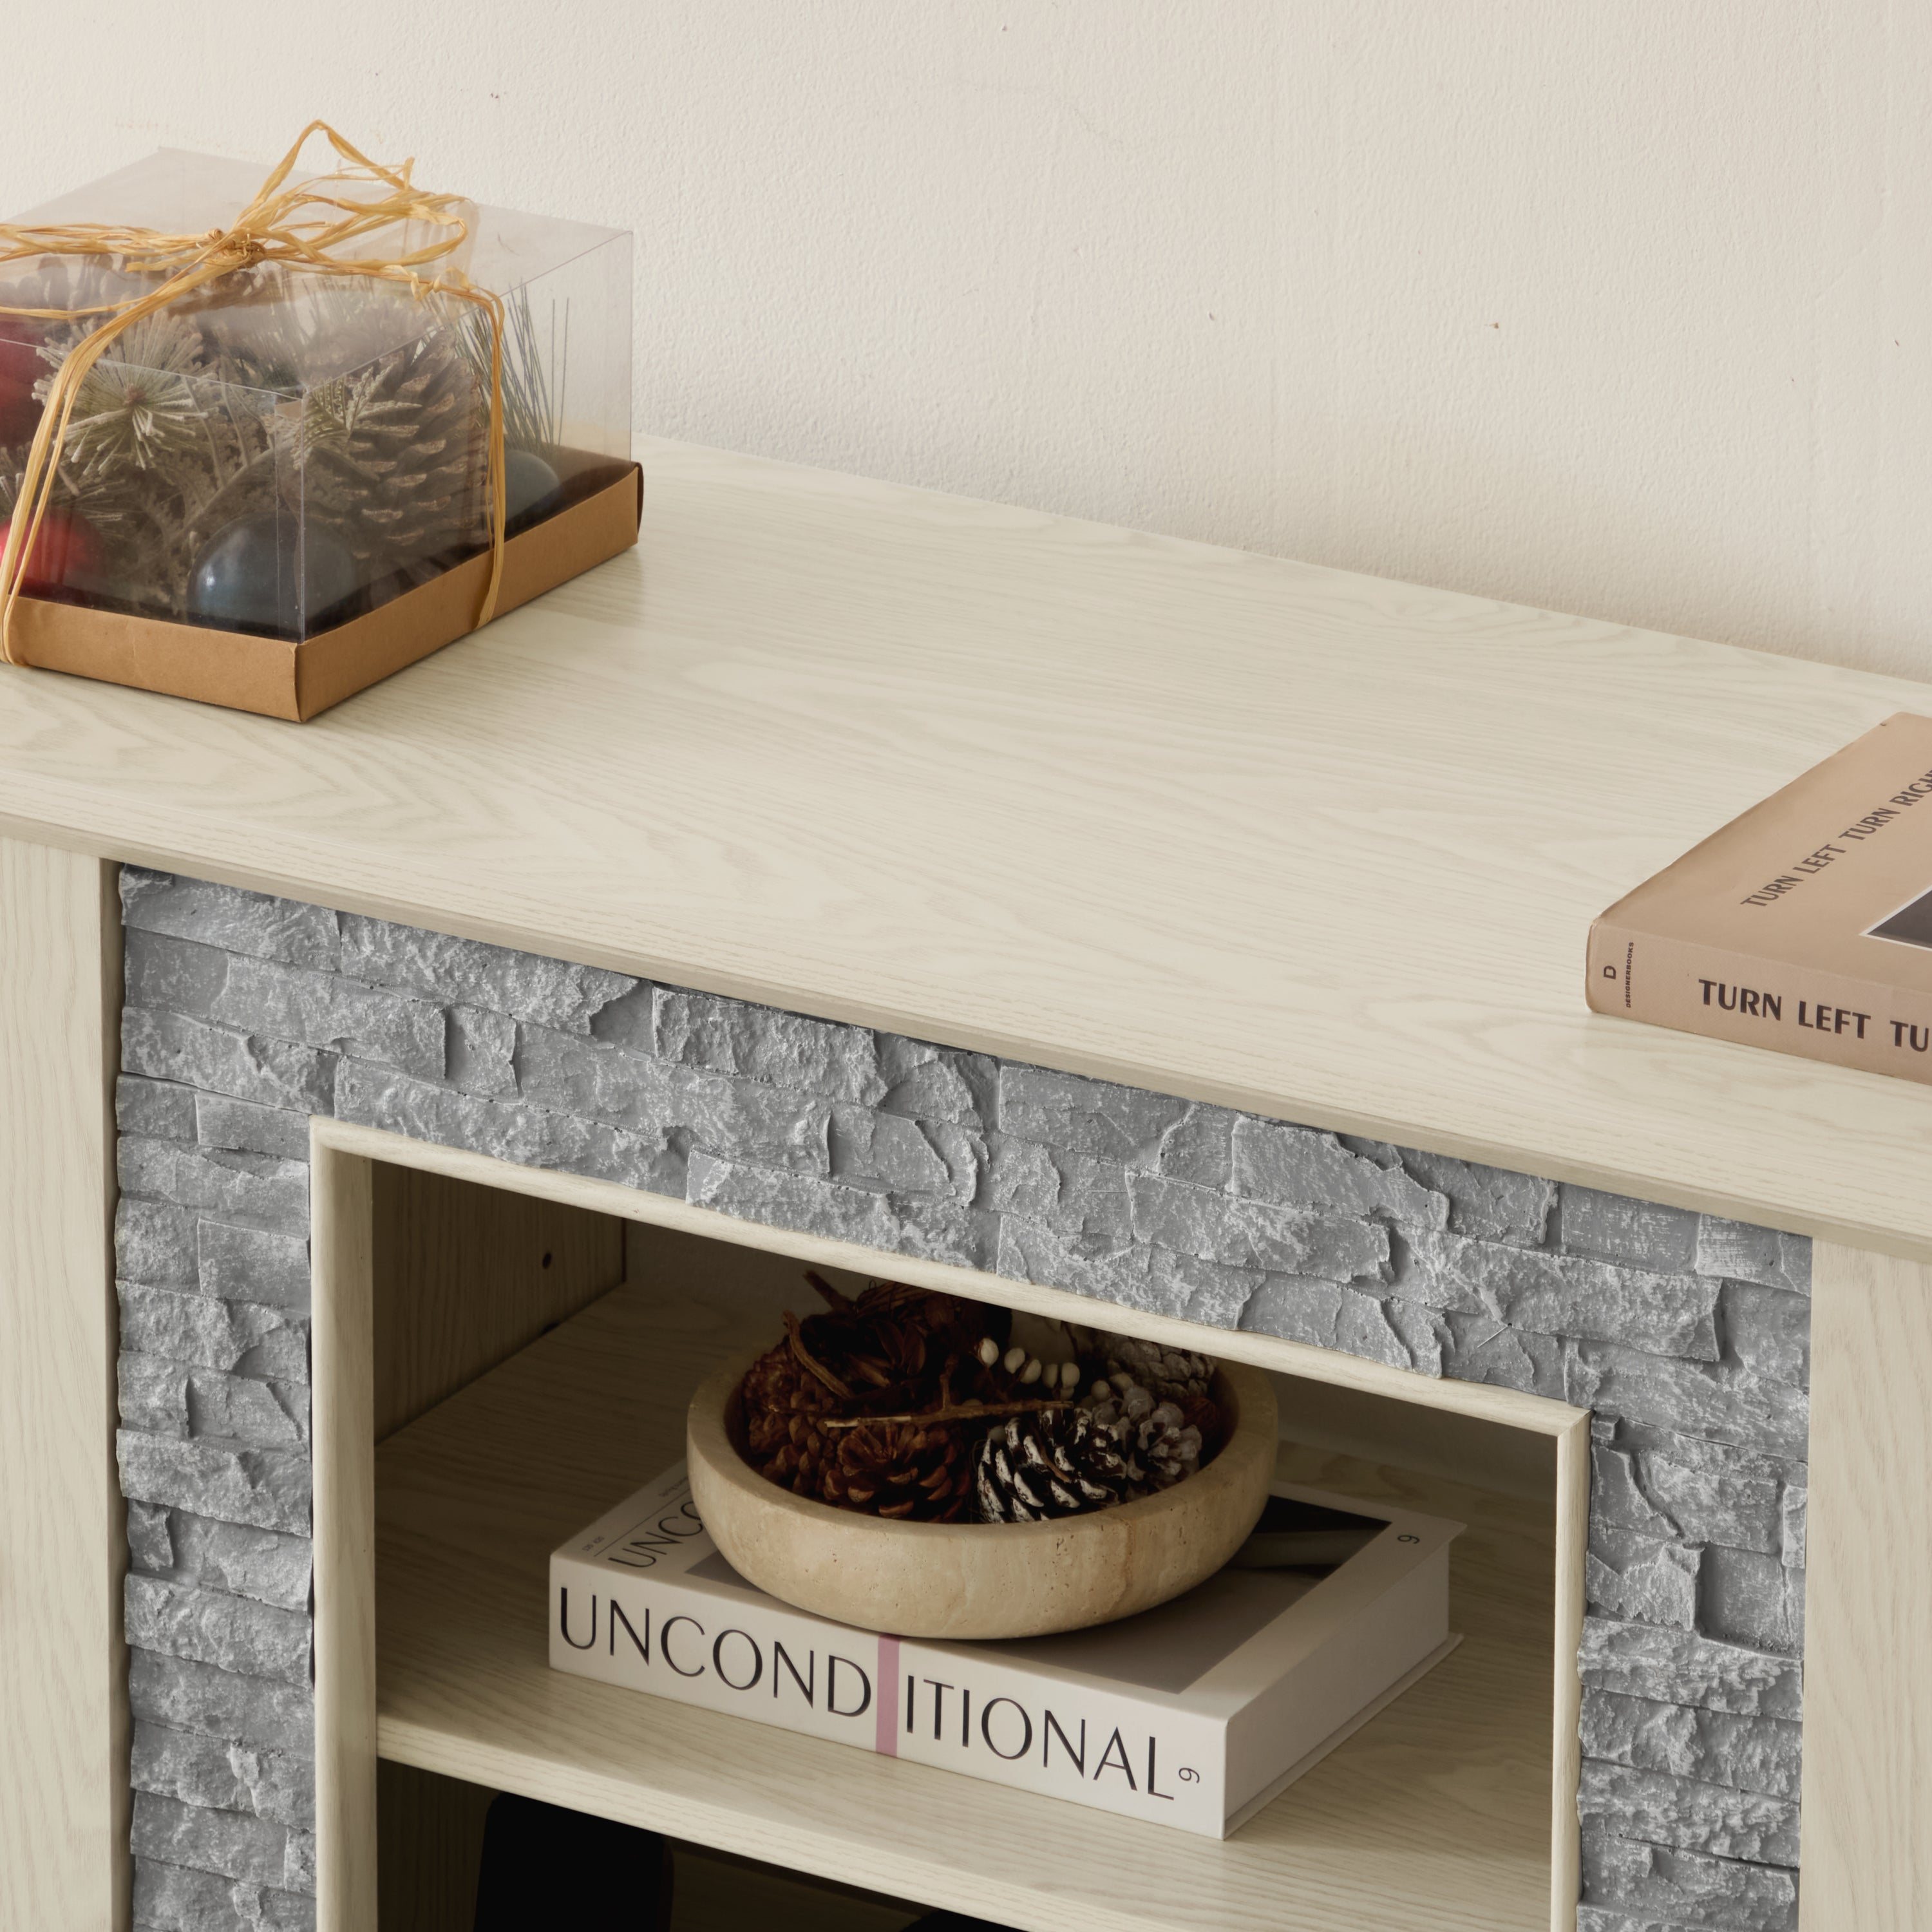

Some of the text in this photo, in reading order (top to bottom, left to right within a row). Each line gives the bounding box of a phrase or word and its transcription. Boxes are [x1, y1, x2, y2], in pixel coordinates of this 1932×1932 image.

[1740, 769, 1932, 907] TURN LEFT TURN RIGH
[1603, 965, 1616, 980] D
[1625, 942, 1634, 1009] DESIGNERBOOKS
[1698, 978, 1929, 1052] TURN LEFT TU
